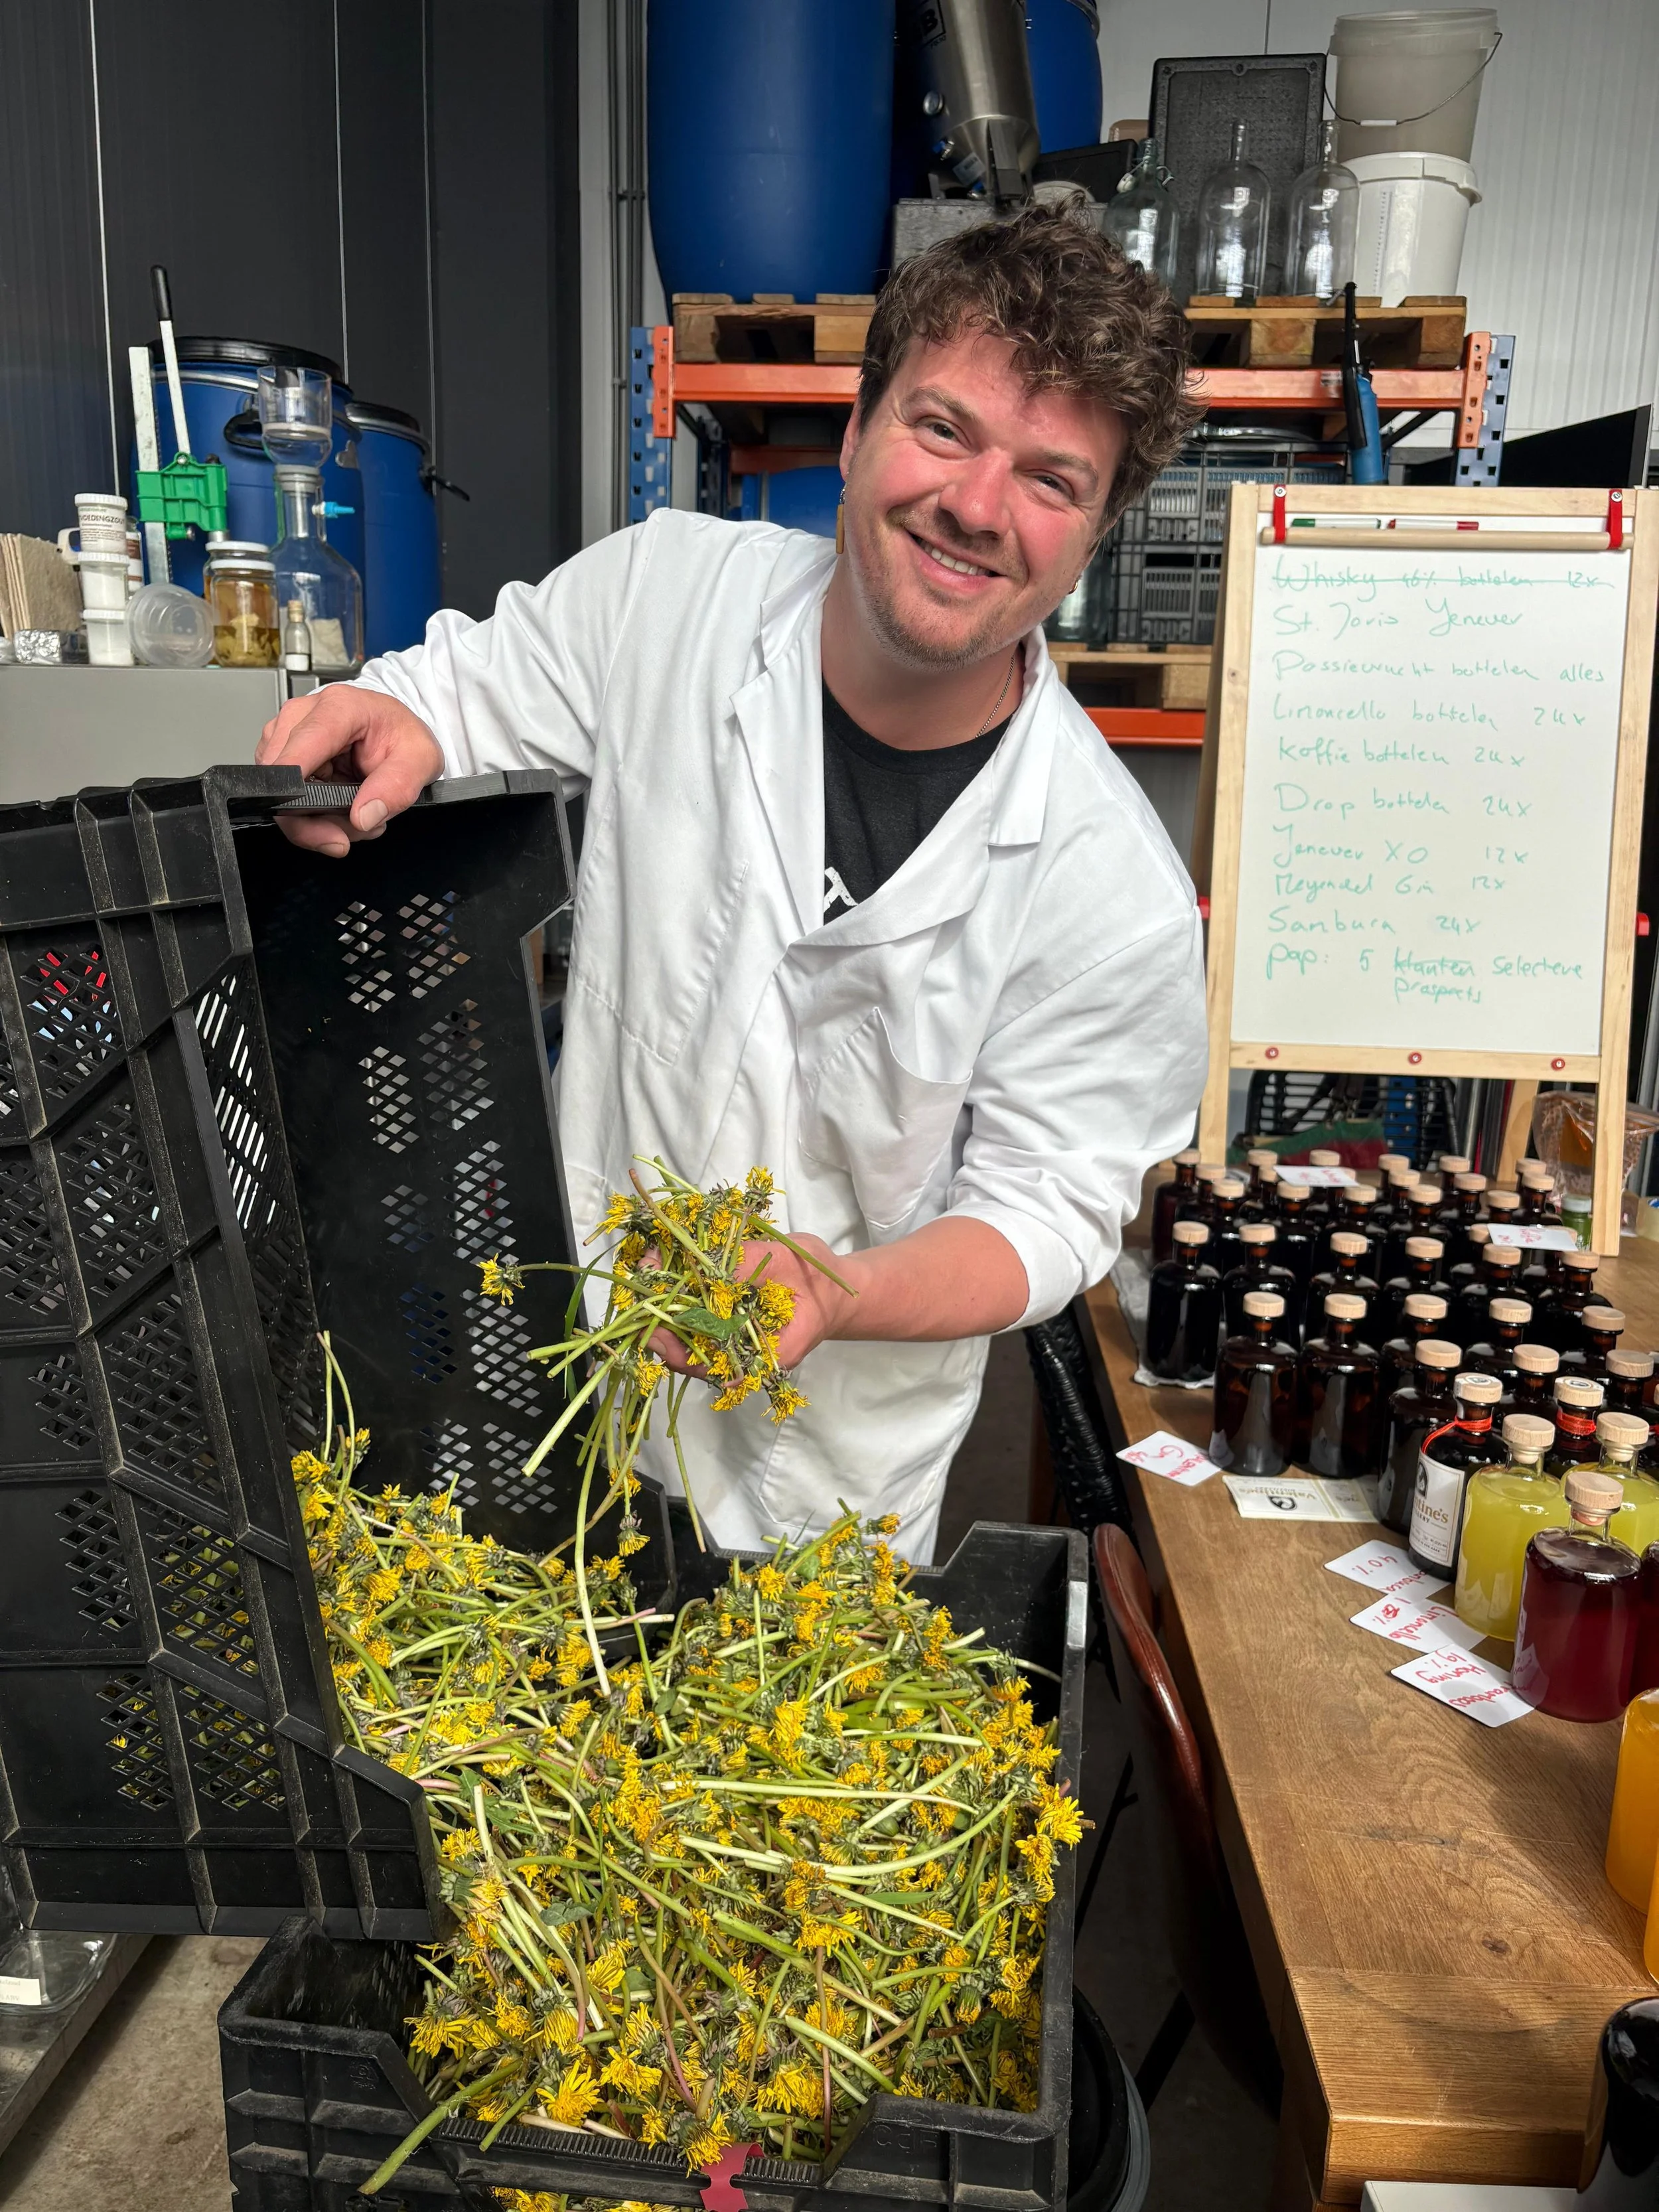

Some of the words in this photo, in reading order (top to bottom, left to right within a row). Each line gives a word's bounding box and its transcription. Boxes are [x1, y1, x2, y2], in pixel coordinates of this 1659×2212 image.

[1275, 553, 1377, 602] Whisky
[1559, 663, 1604, 682] alles
[1273, 693, 1386, 721] Limoncello
[1273, 782, 1355, 821] Drop
[1414, 1663, 1486, 1685] Honing
